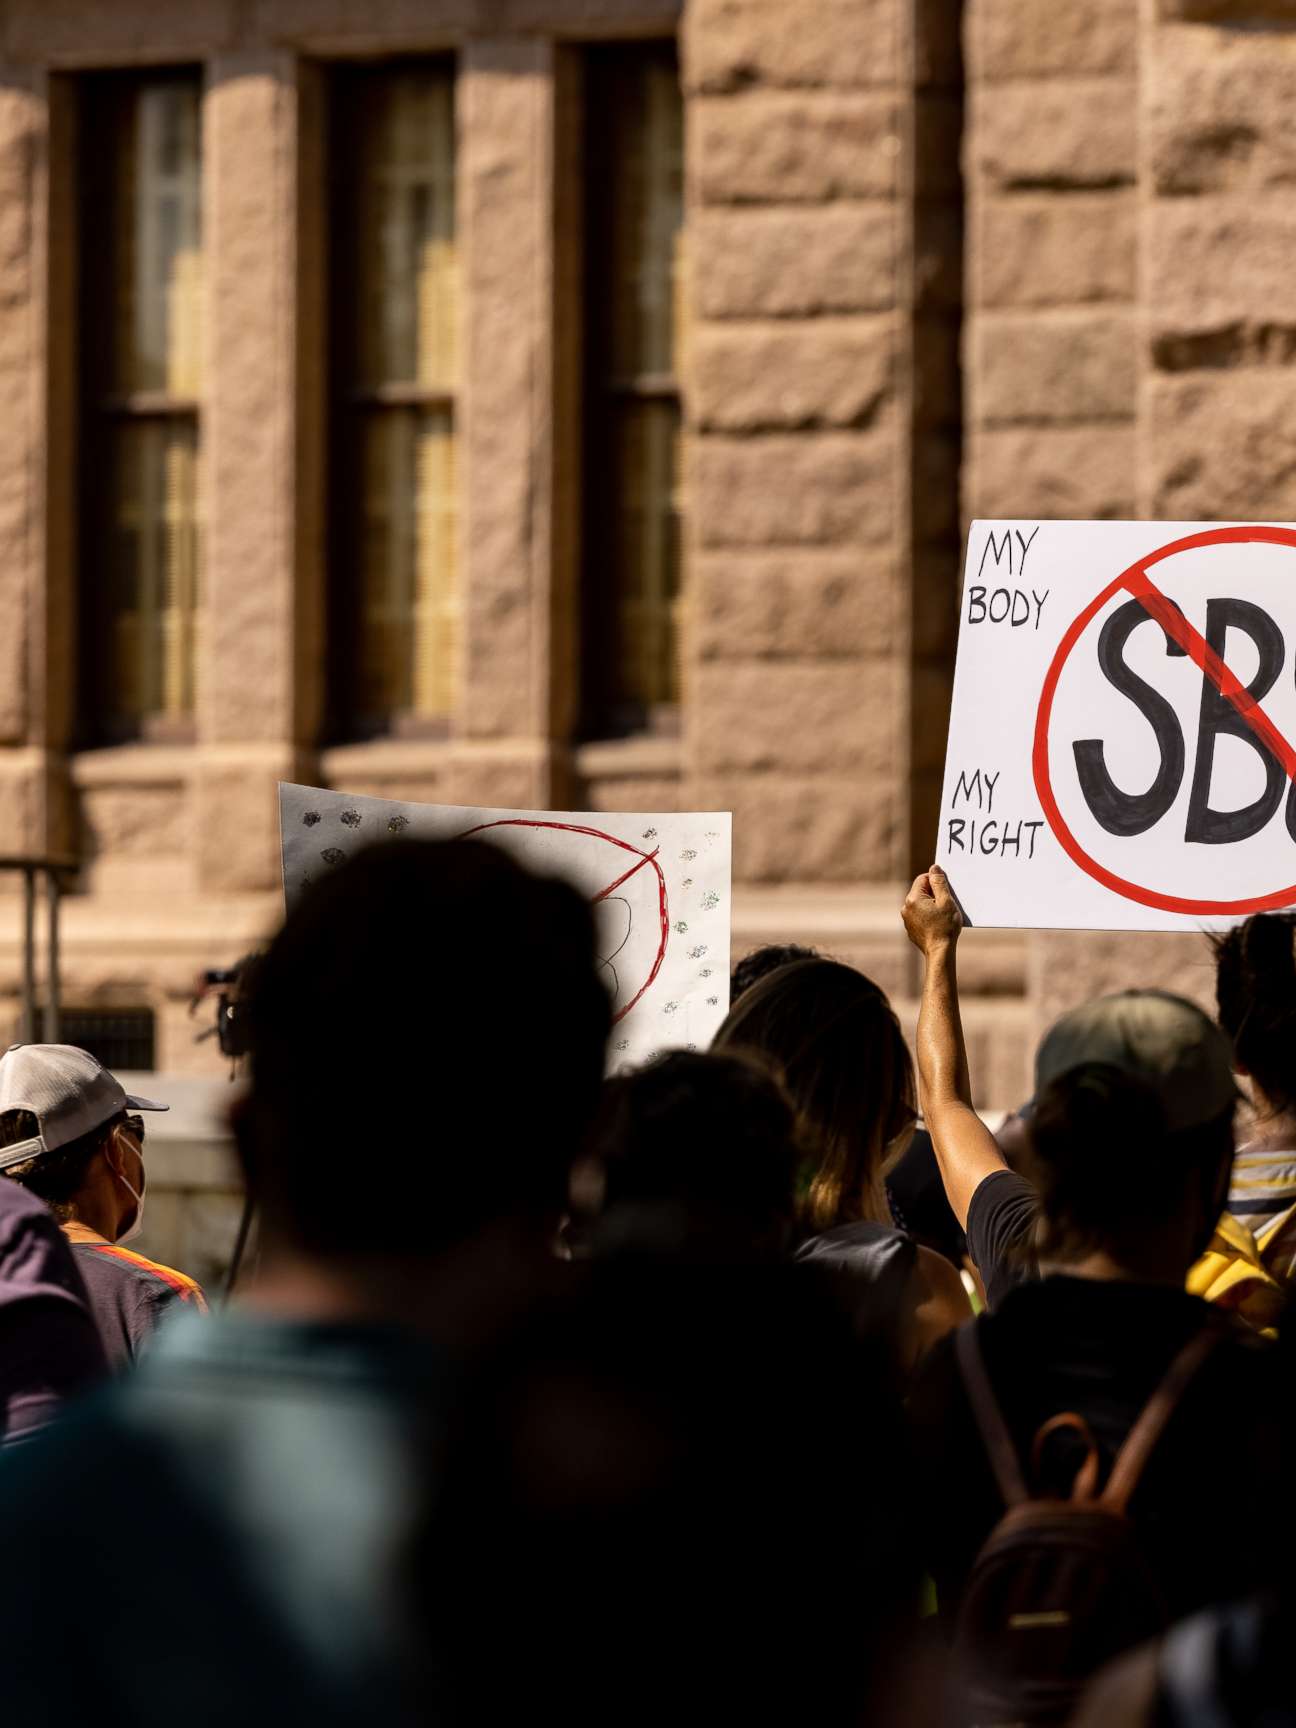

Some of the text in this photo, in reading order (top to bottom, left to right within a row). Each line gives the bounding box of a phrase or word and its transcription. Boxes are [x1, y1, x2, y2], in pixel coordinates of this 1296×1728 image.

[978, 525, 1040, 577] MY
[967, 585, 1050, 631] BODY
[952, 767, 1000, 814] MY
[947, 819, 1045, 860] RIGHT
